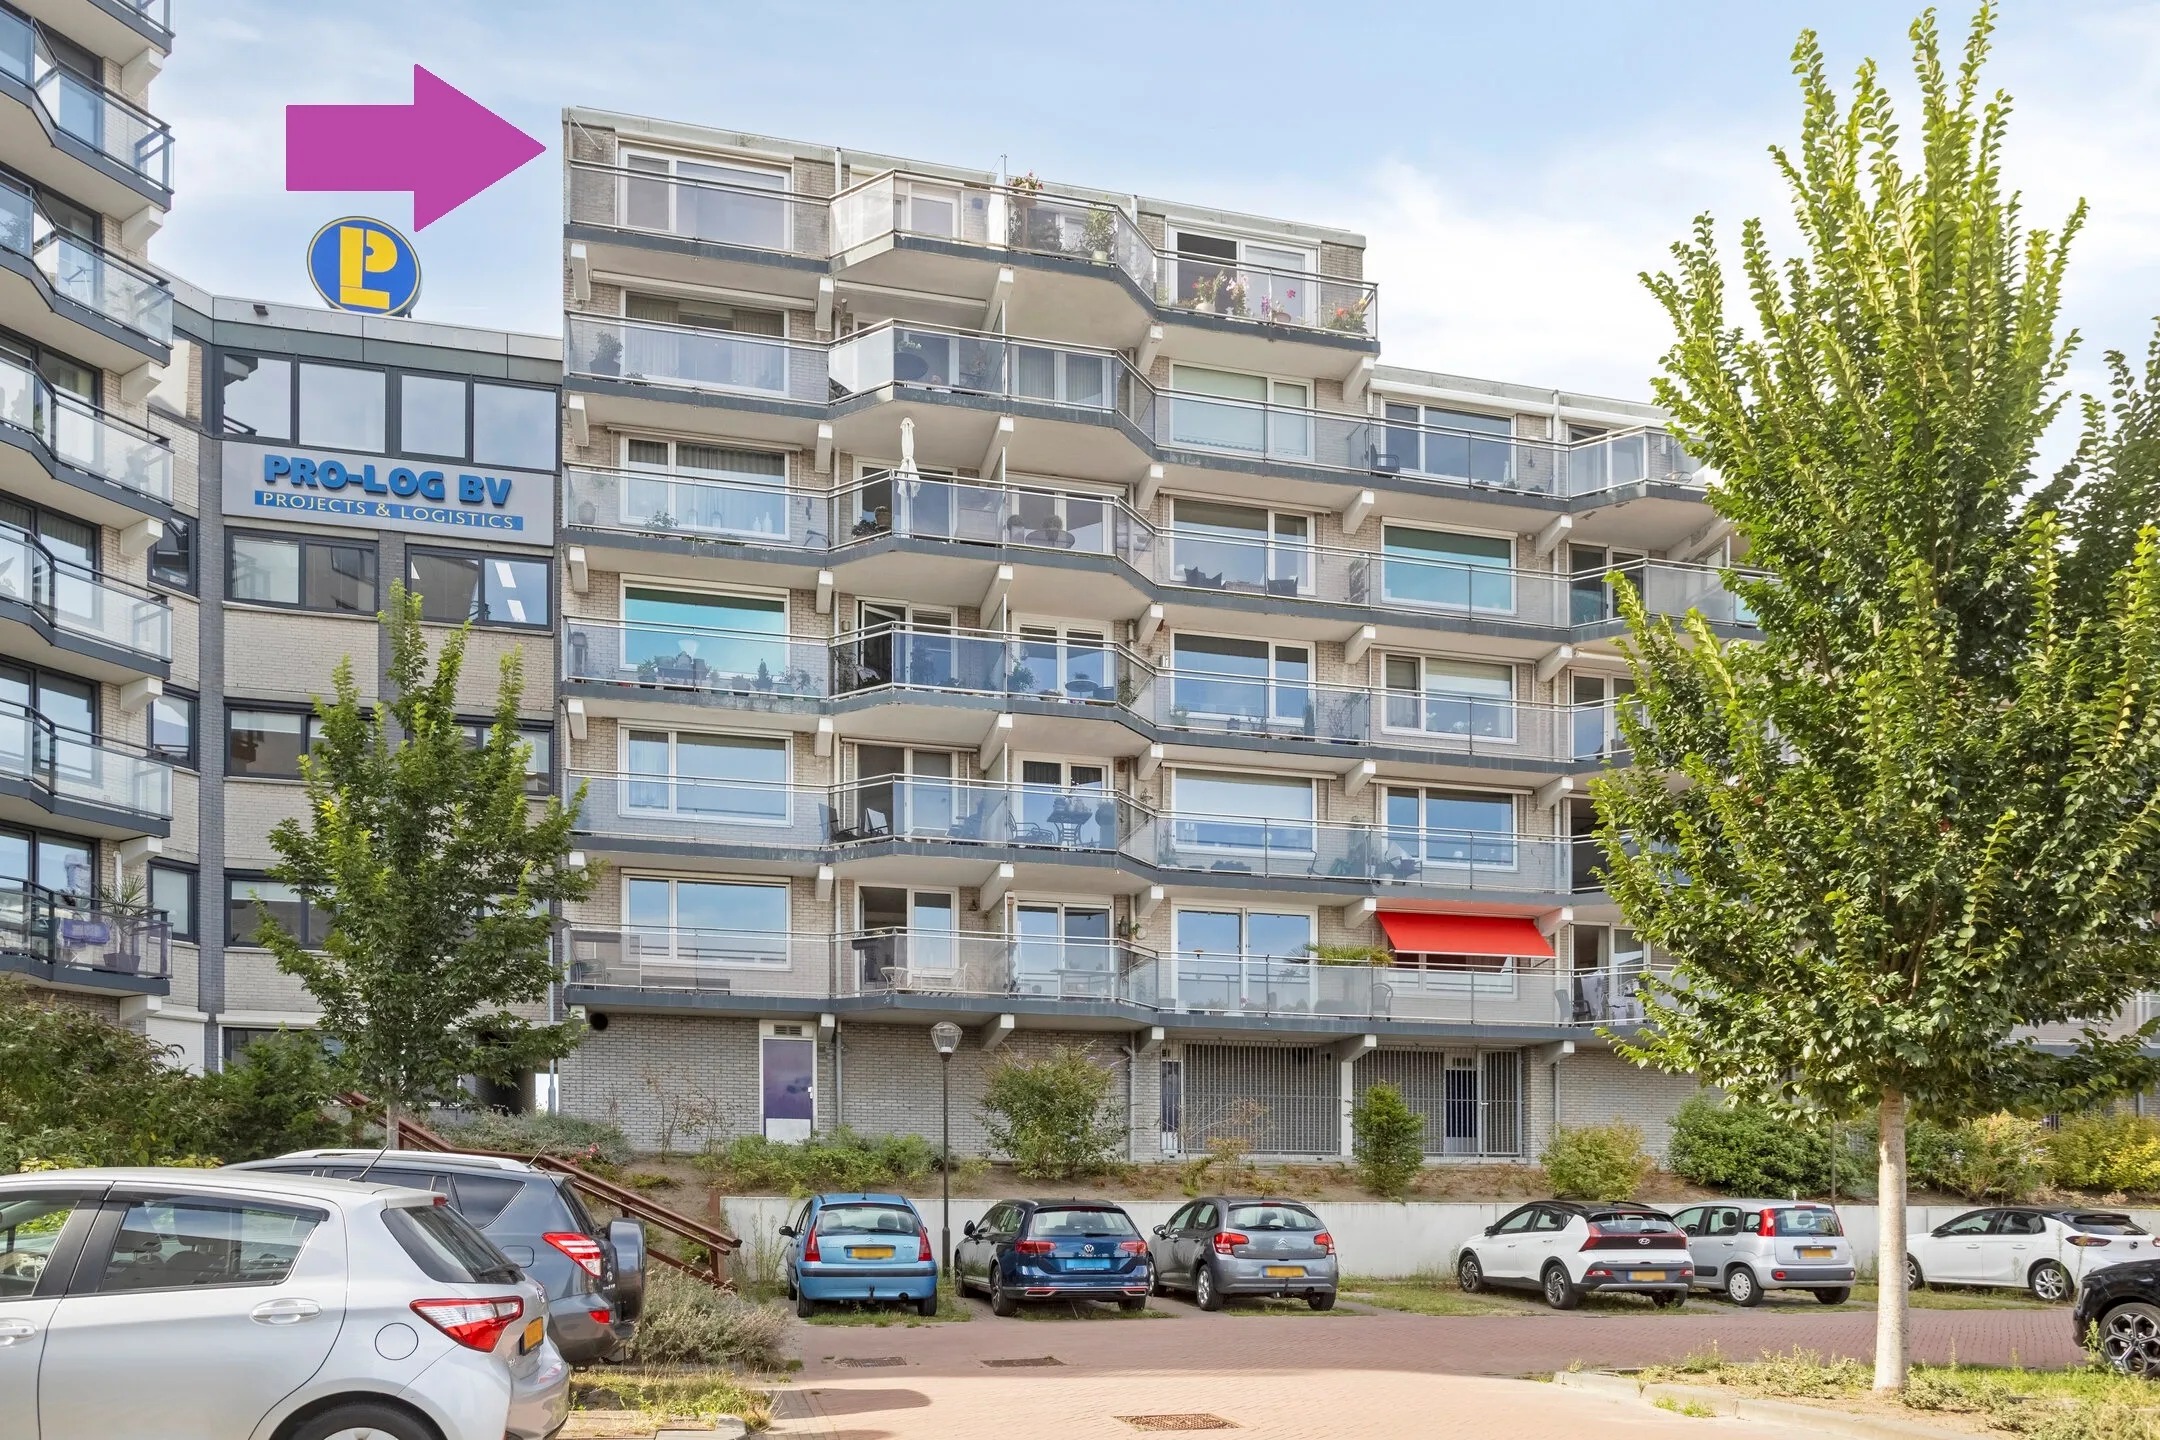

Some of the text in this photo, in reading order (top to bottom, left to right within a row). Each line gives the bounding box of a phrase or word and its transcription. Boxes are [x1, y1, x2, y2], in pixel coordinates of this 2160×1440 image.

[264, 454, 512, 505] PRO-LOG BV
[263, 492, 513, 529] PROJECTS & LOGISTICS
